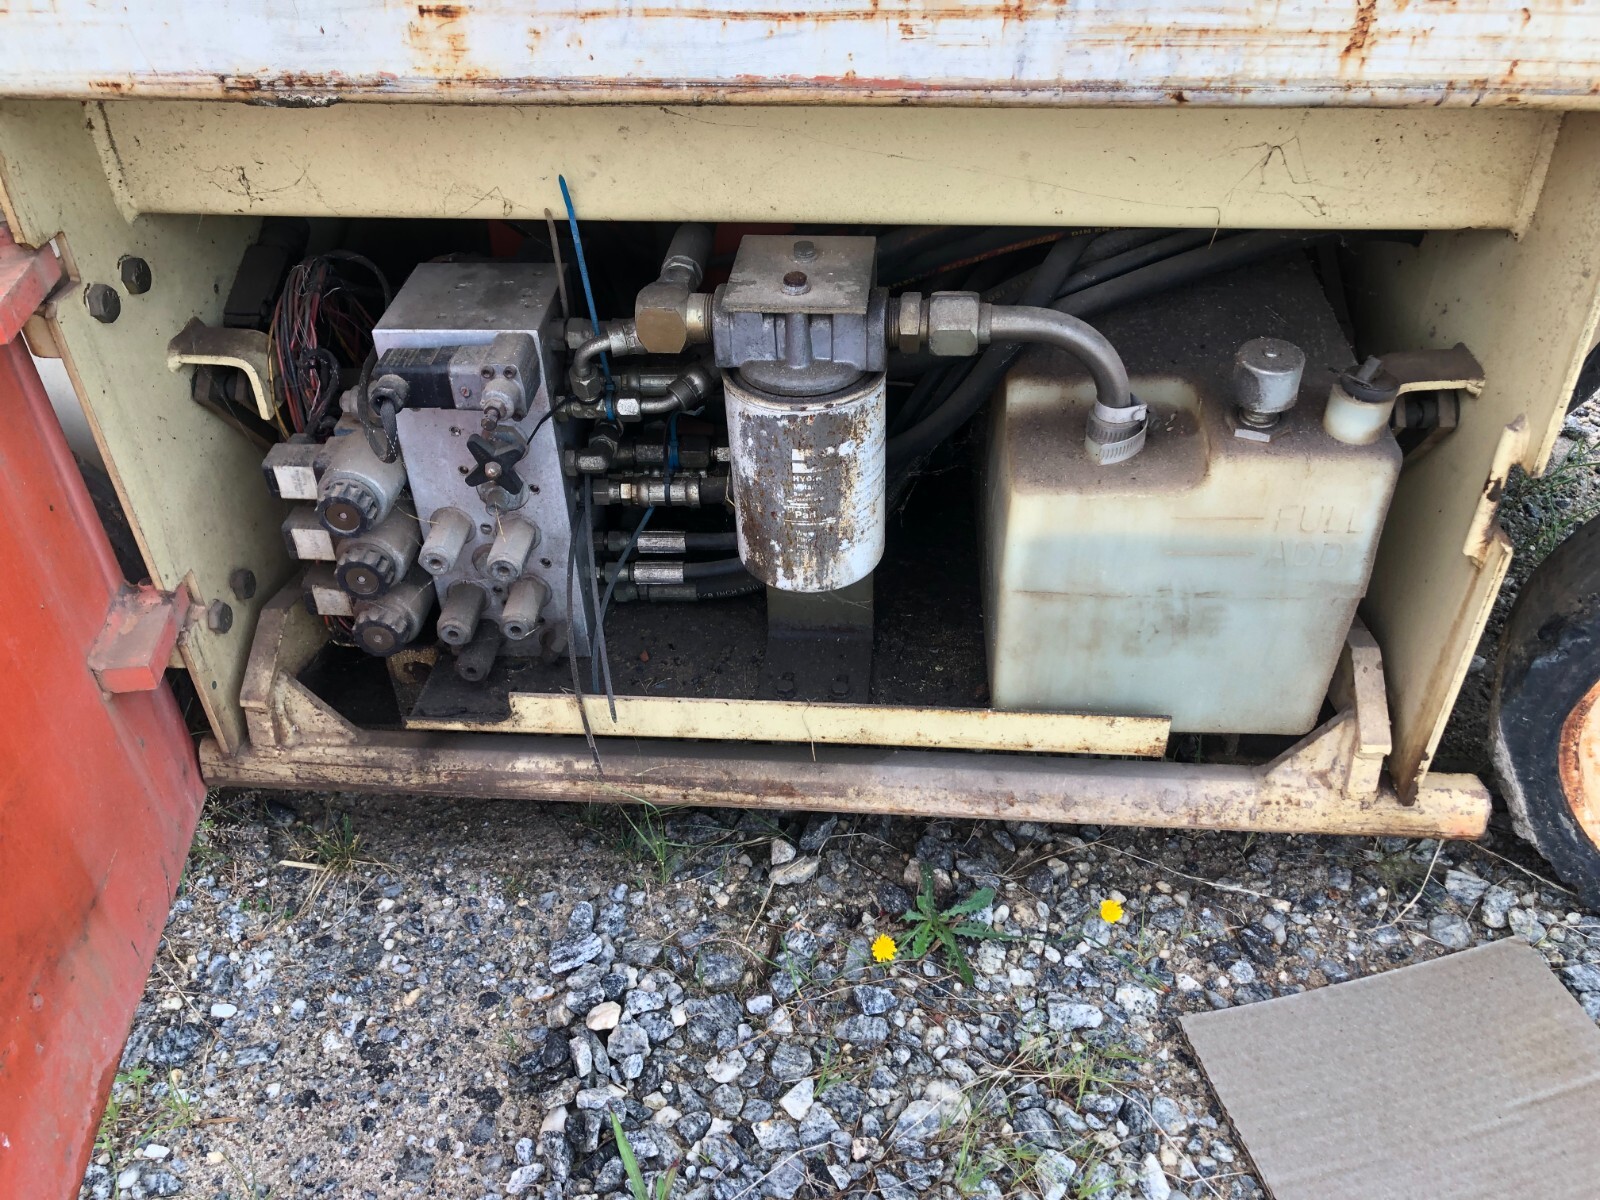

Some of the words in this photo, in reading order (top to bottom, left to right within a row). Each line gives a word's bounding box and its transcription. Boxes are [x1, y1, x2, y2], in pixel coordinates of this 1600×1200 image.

[1272, 504, 1363, 534] FULL
[1264, 540, 1344, 568] ADD
[716, 588, 737, 596] INCH
